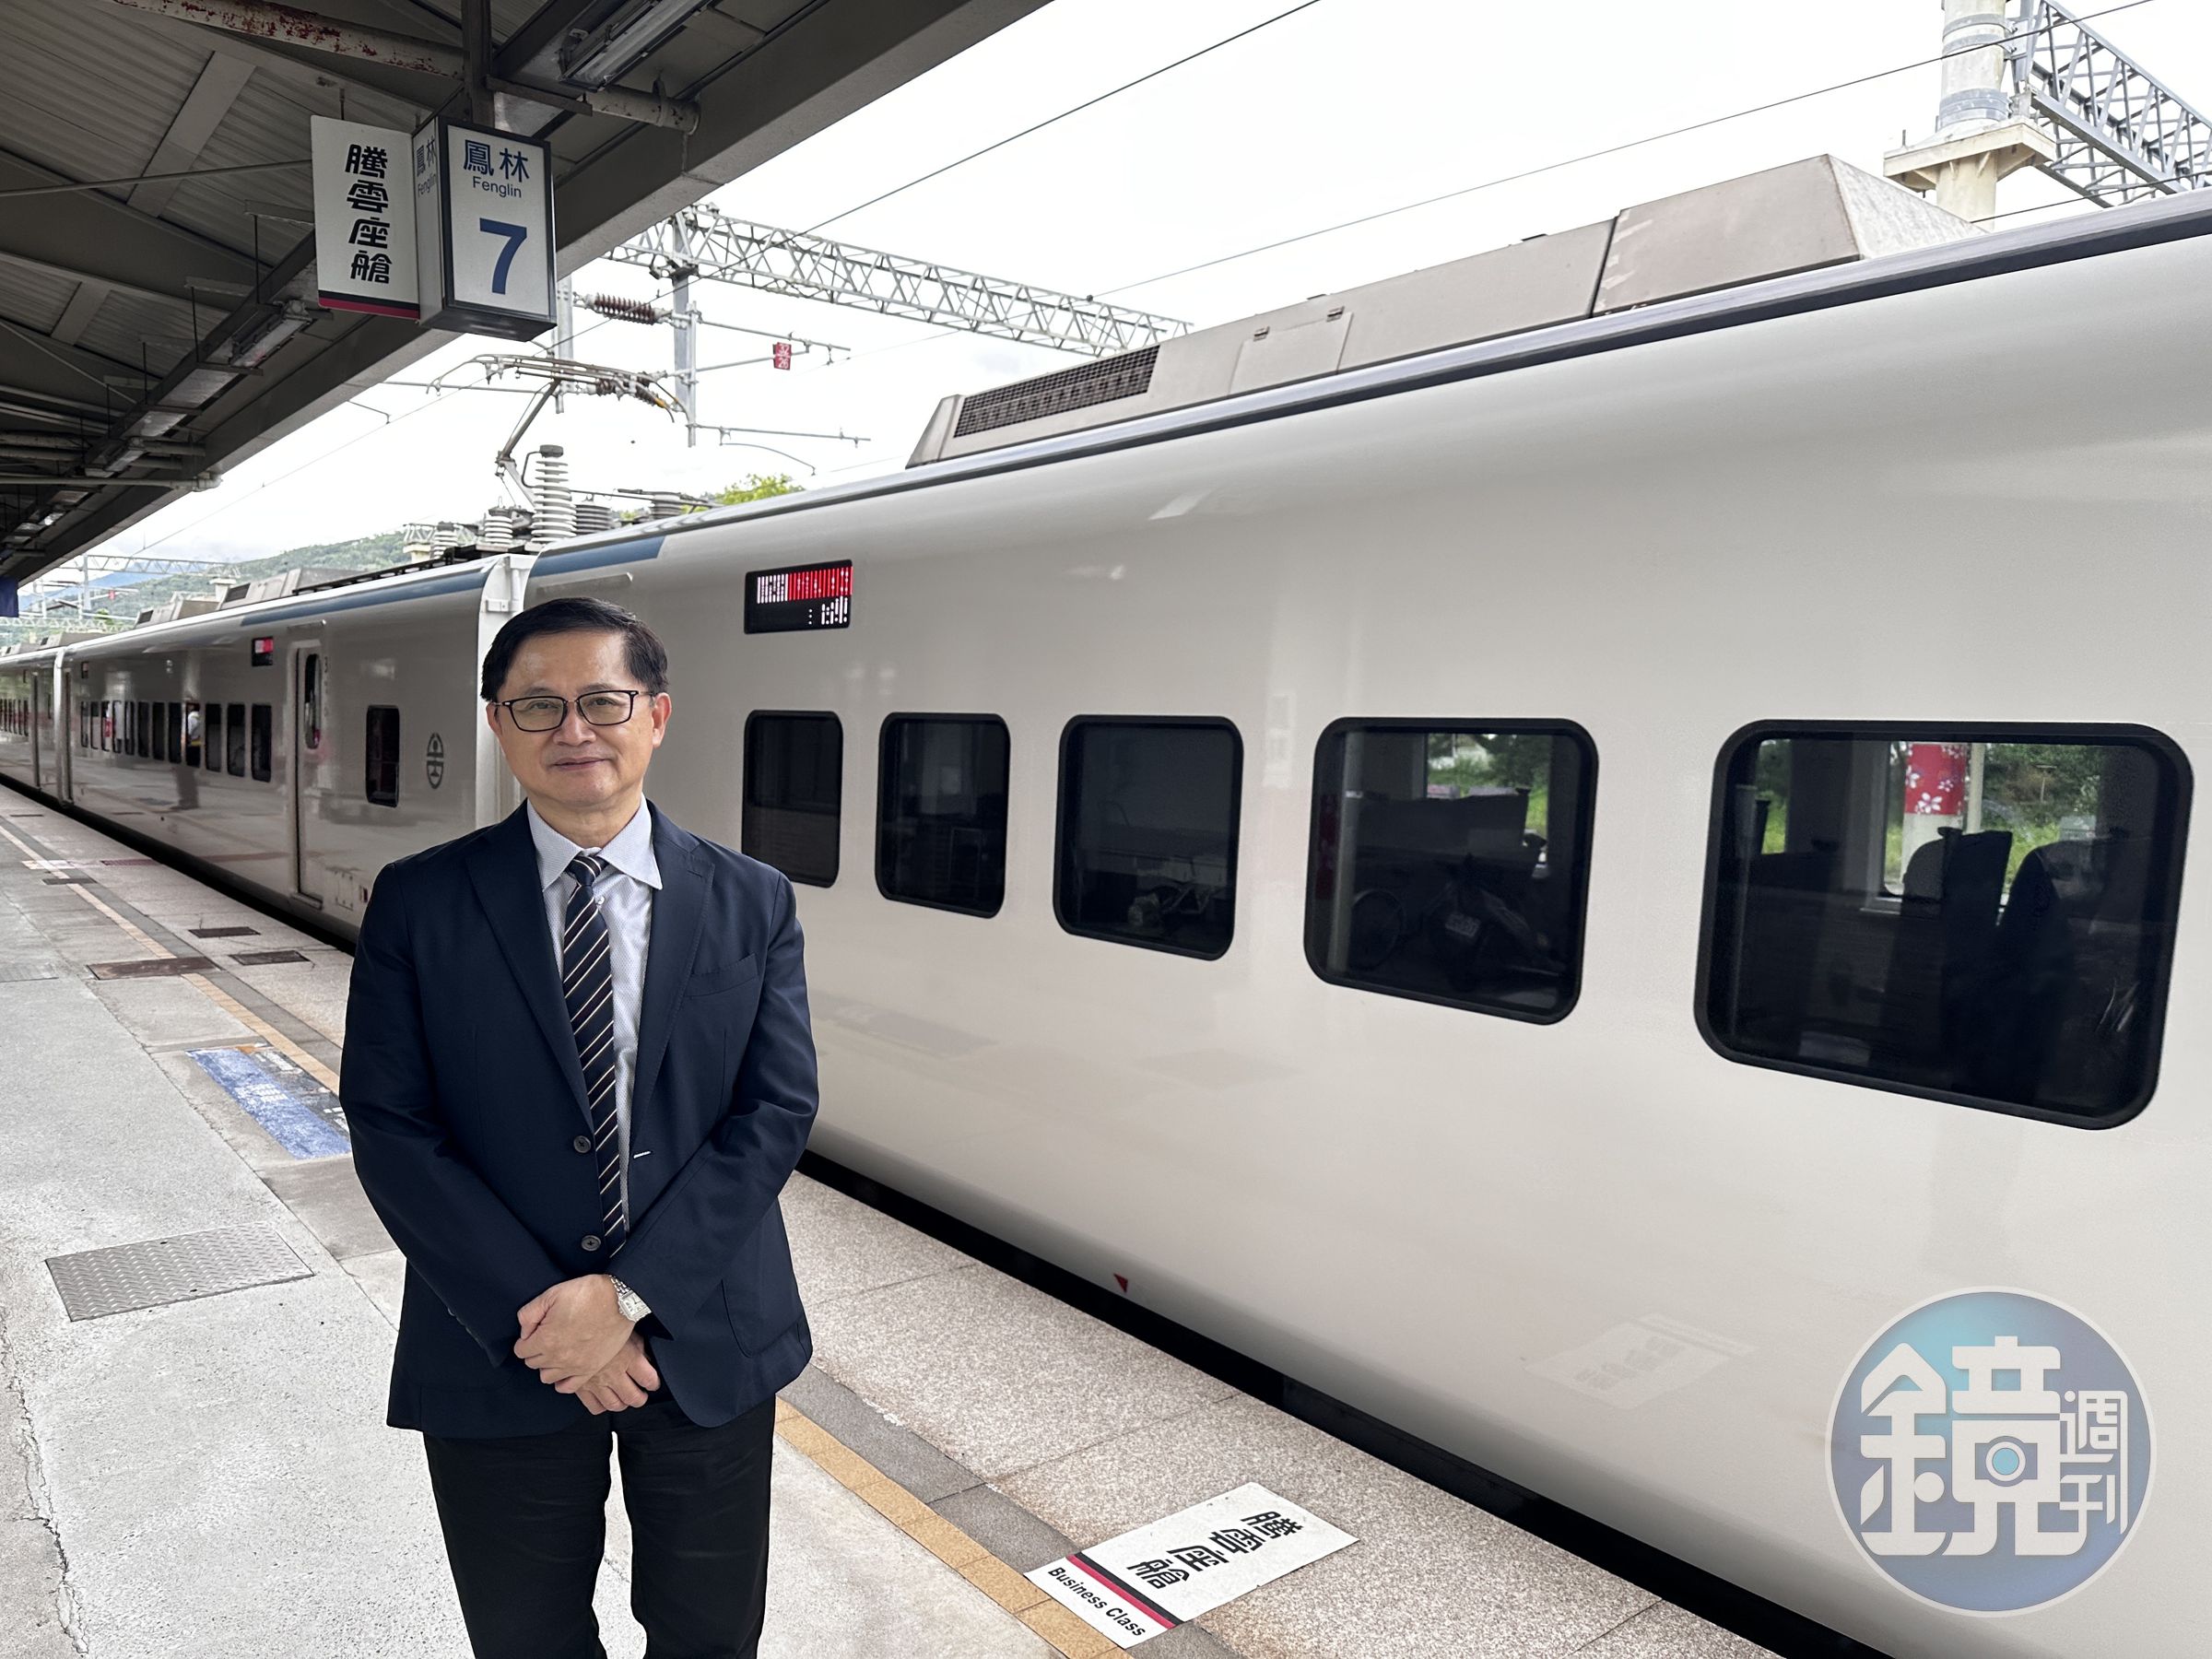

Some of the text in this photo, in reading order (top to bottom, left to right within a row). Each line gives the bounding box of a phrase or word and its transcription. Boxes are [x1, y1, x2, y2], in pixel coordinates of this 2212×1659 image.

[463, 139, 530, 183] 鳳林
[472, 175, 523, 199] Fenglin
[345, 144, 393, 285] 騰雲座艙
[478, 217, 528, 296] 7
[1047, 1567, 1147, 1636] Business Class
